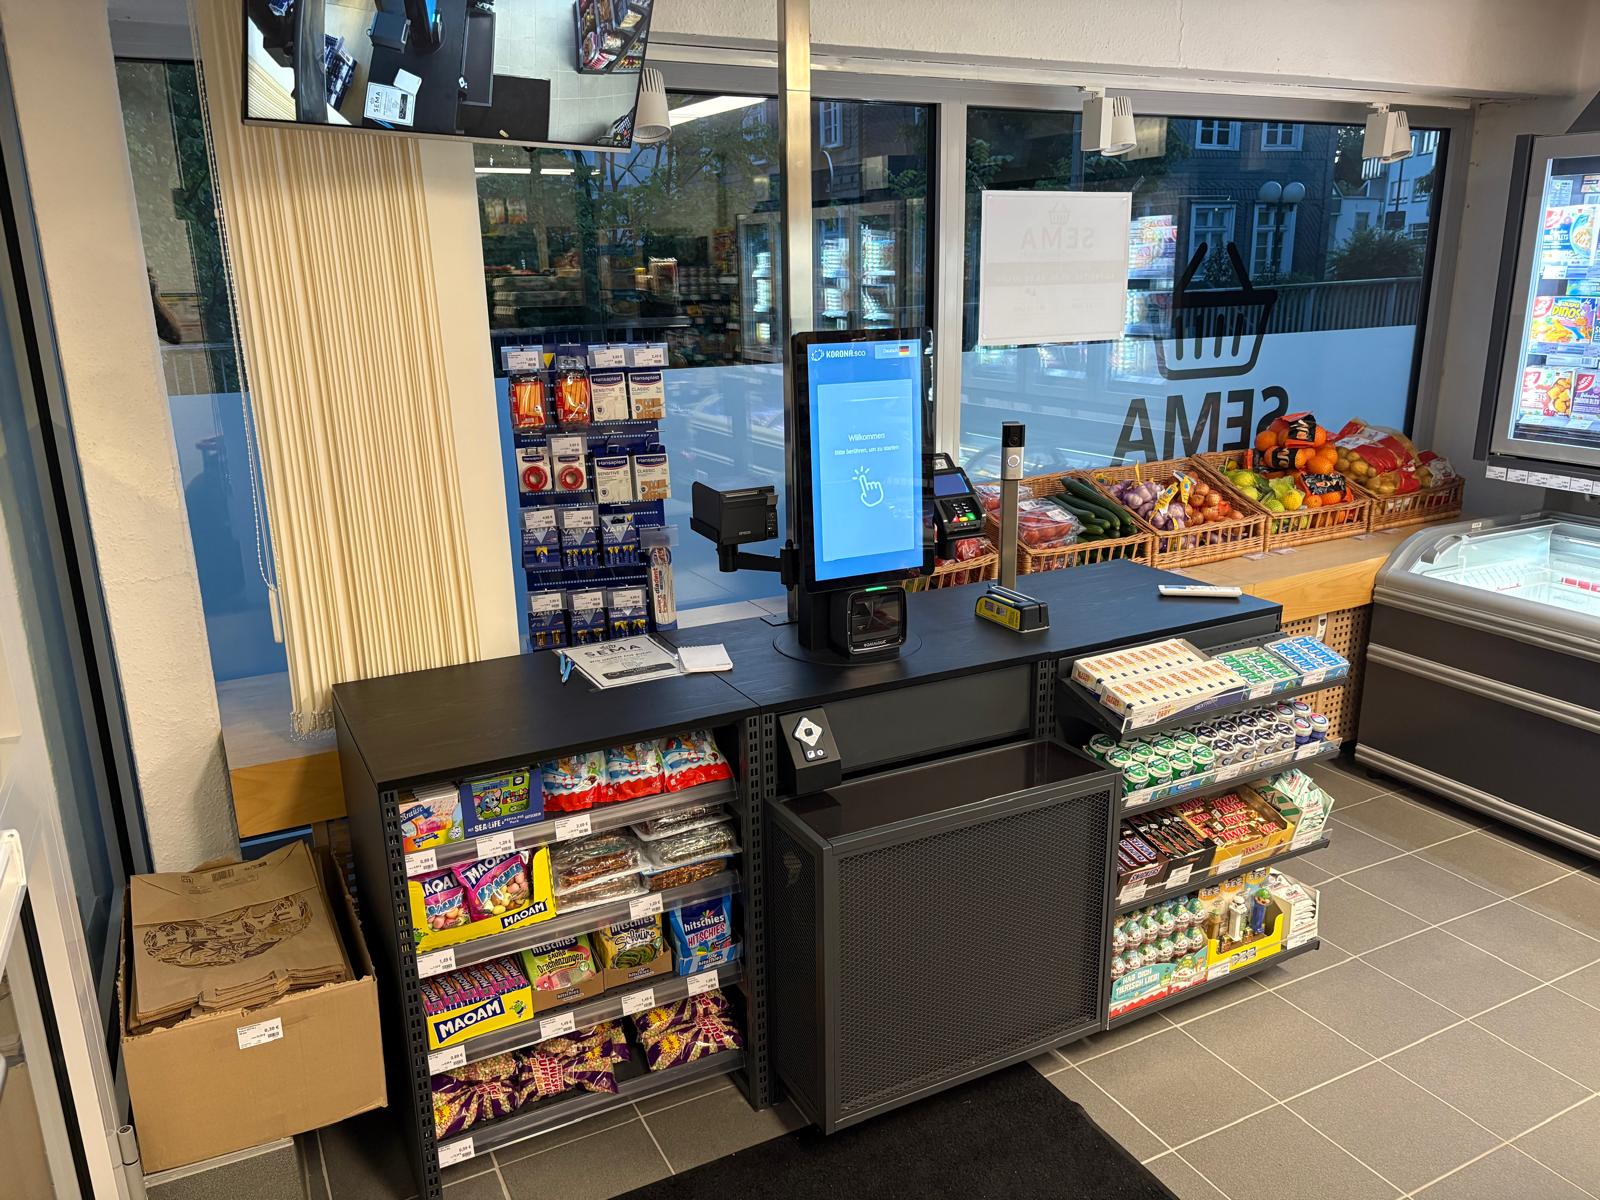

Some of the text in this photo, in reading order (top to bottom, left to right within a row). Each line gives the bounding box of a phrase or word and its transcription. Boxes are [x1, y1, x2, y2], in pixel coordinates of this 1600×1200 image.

[373, 91, 381, 113] SEMA
[593, 375, 621, 383] Hansaplast
[848, 432, 885, 442] Willkommen
[584, 644, 641, 657] SEMA
[1211, 793, 1241, 809] TWIX
[474, 823, 488, 832] SEA
[1219, 814, 1249, 826] TWIX
[1219, 825, 1251, 841] TWIX
[504, 902, 545, 928] MAOAM
[684, 914, 724, 932] hitschies
[687, 922, 726, 947] HITSCHIES
[537, 953, 584, 974] Drachenzungen
[438, 1000, 501, 1039] MAOAM
